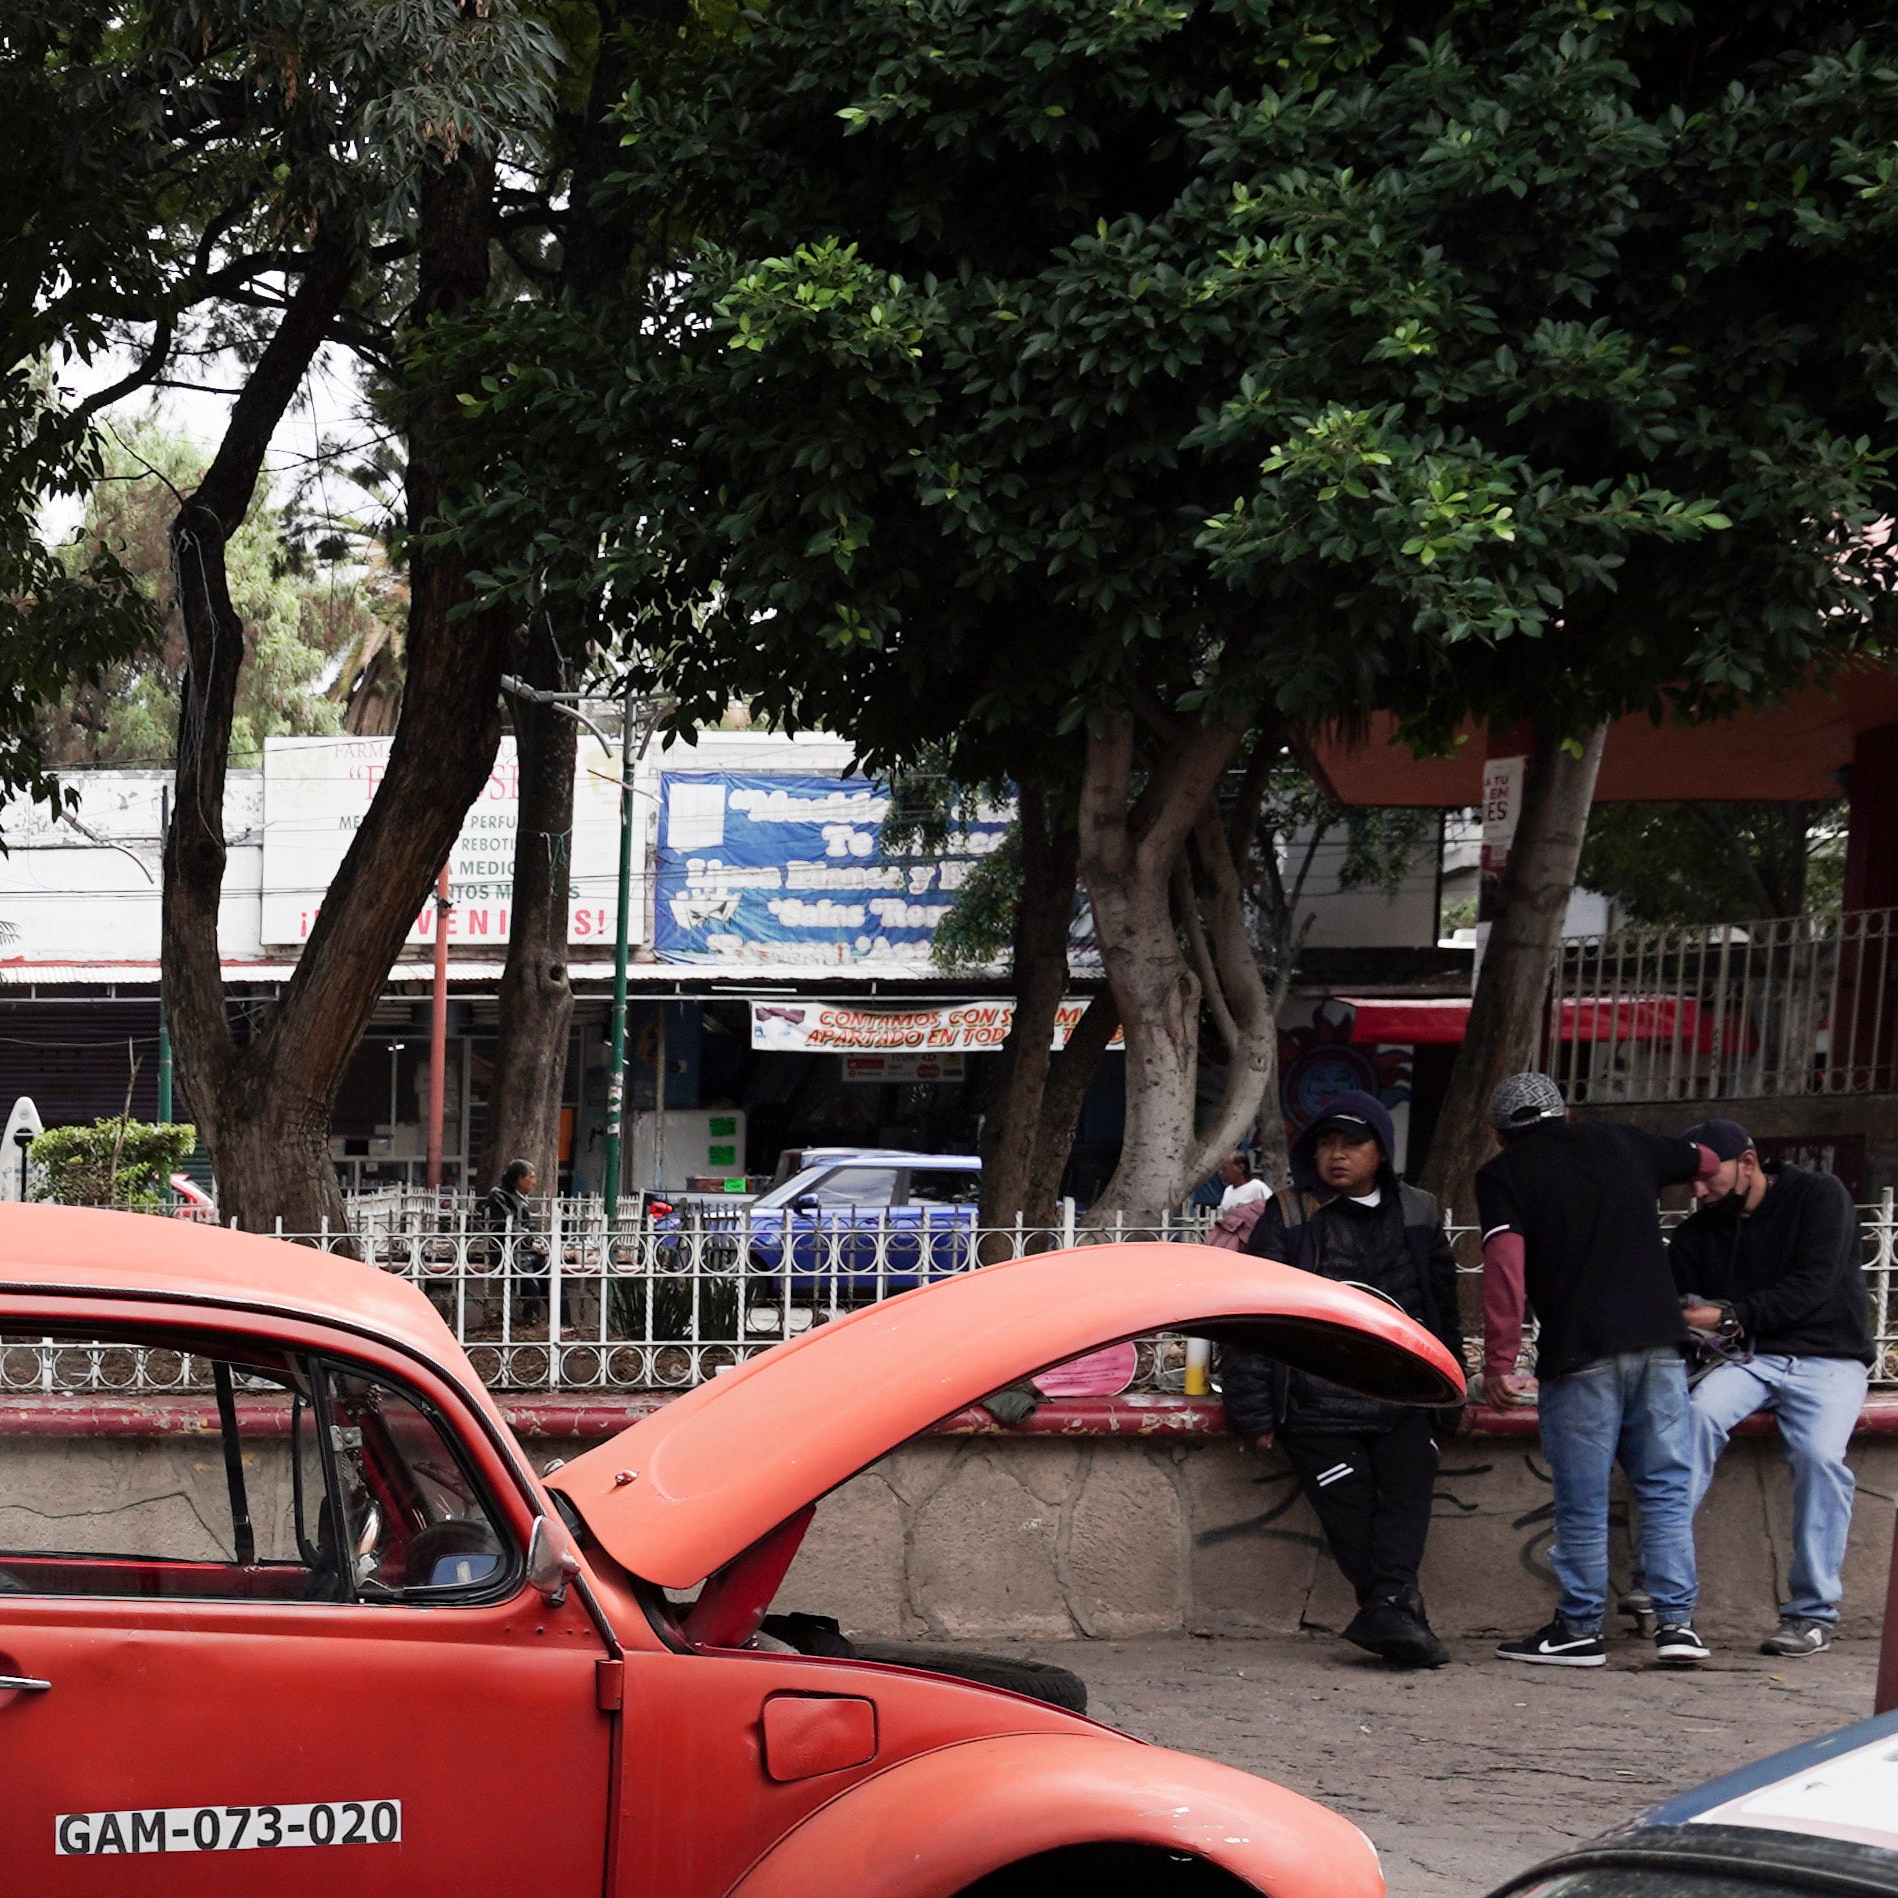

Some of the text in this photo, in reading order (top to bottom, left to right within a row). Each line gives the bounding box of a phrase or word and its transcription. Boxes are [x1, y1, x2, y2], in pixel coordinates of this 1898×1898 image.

[471, 816, 517, 830] PERFU
[461, 837, 515, 852] REBOTI
[460, 860, 515, 876] MEDIC
[819, 1008, 941, 1028] CONTAMOS
[947, 1007, 997, 1027] CON
[805, 1027, 1009, 1049] APARTADO EN TOD
[59, 1801, 399, 1855] GAM-073-020
